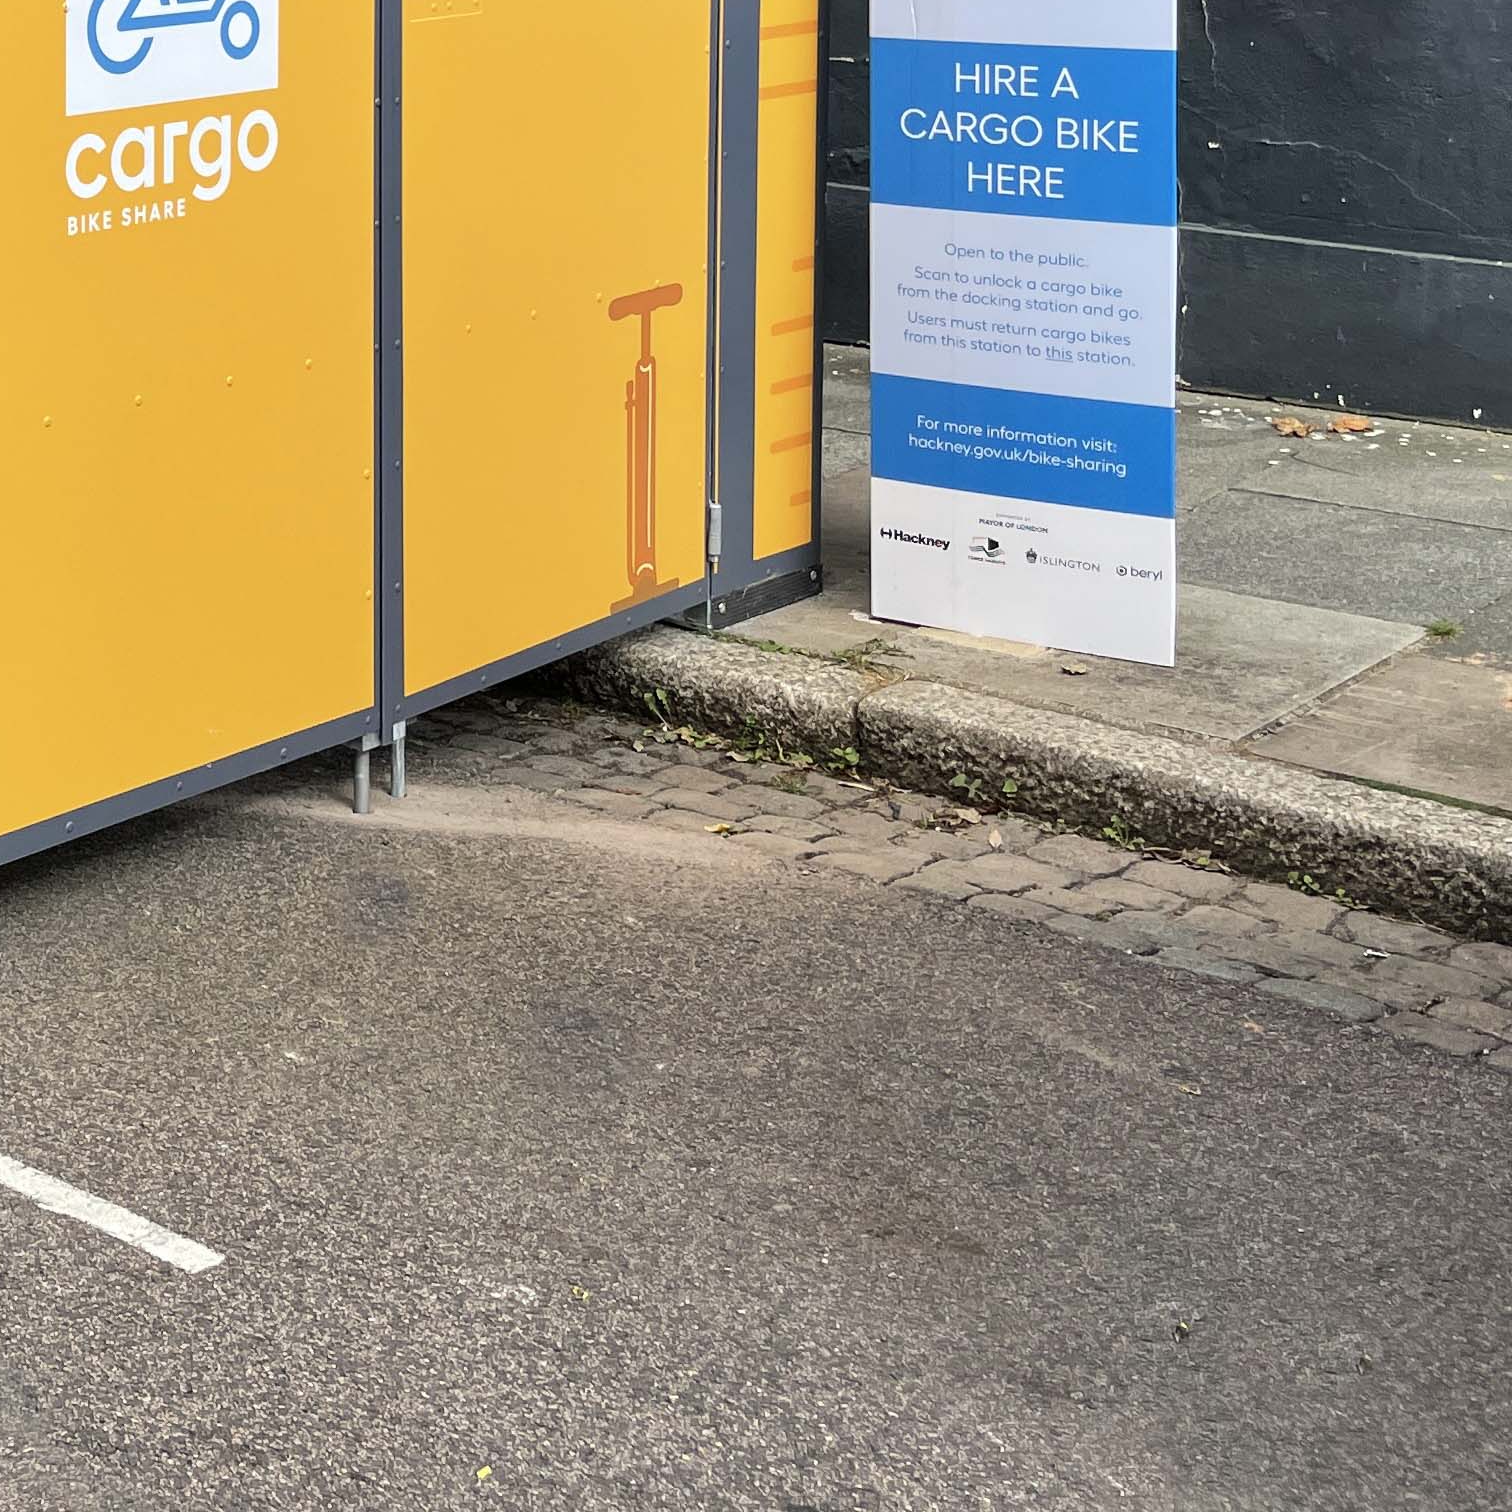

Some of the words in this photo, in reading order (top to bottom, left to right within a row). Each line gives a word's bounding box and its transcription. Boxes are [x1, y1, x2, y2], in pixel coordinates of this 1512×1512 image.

[955, 63, 1039, 97] HIRE
[1051, 67, 1079, 99] A
[900, 108, 1043, 147] CARGO
[1057, 118, 1138, 153] BIKE
[65, 109, 279, 201] cargo
[967, 161, 1064, 199] HERE
[66, 210, 112, 236] BIKE
[121, 197, 187, 227] SHARE
[945, 243, 985, 259] Open
[990, 247, 1004, 261] to
[1009, 250, 1034, 263] the
[1038, 252, 1088, 268] public.
[914, 267, 950, 282] Scan
[954, 271, 968, 284] to
[973, 272, 1022, 290] unlock
[1027, 281, 1036, 290] a
[1041, 281, 1086, 296] cargo
[1090, 283, 1123, 298] bike
[897, 284, 930, 299] from
[934, 289, 958, 302] the
[962, 291, 1021, 311] docking
[1026, 297, 1078, 314] station
[1083, 303, 1114, 318] and
[1118, 307, 1142, 321] go.
[907, 311, 946, 328] Users
[950, 316, 988, 332] must
[991, 320, 1036, 337] return
[1041, 327, 1086, 343] cargo
[1091, 330, 1131, 346] bikes
[904, 329, 937, 345] from
[941, 335, 966, 349] this
[971, 338, 1022, 355] station
[1026, 344, 1041, 357] to
[1046, 345, 1073, 359] this
[1077, 349, 1135, 367] station.
[917, 415, 939, 430] For
[943, 423, 983, 437] more
[987, 425, 1077, 449] information
[1082, 438, 1116, 454] visit:
[908, 434, 1127, 478] hackney.gov.uk/bike-sharing
[894, 530, 950, 551] Hackney
[979, 518, 1003, 527] MAYOR
[1017, 524, 1048, 533] LONDON
[1039, 555, 1101, 573] ISLINGTON
[1131, 566, 1163, 581] beryl
